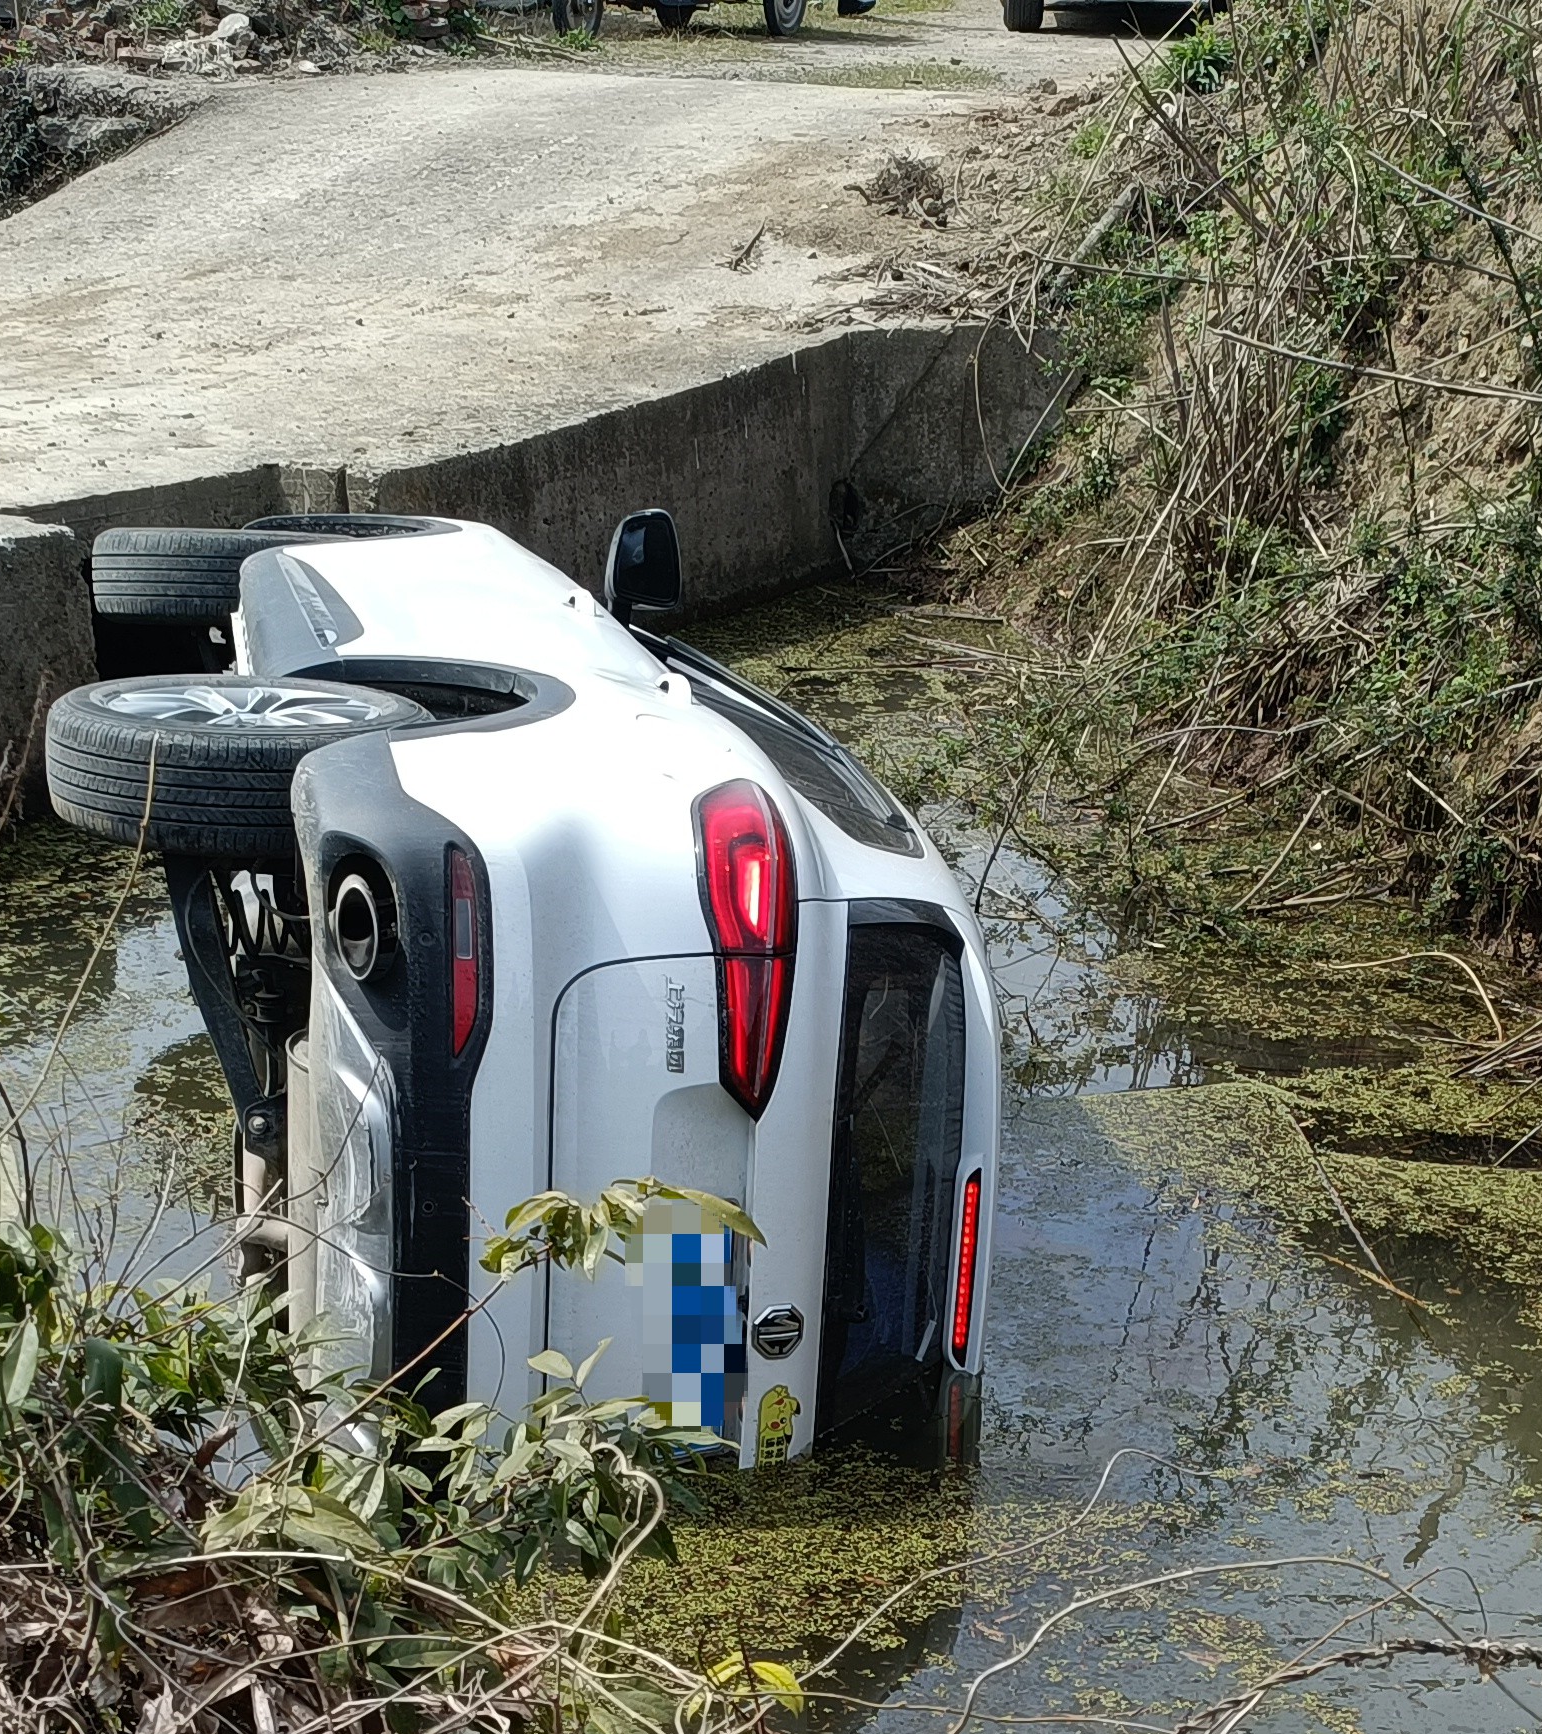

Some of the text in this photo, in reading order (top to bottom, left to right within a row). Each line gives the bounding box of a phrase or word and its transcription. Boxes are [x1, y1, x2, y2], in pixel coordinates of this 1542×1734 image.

[665, 976, 685, 1073] 上汽集团
[756, 1308, 802, 1356] MG
